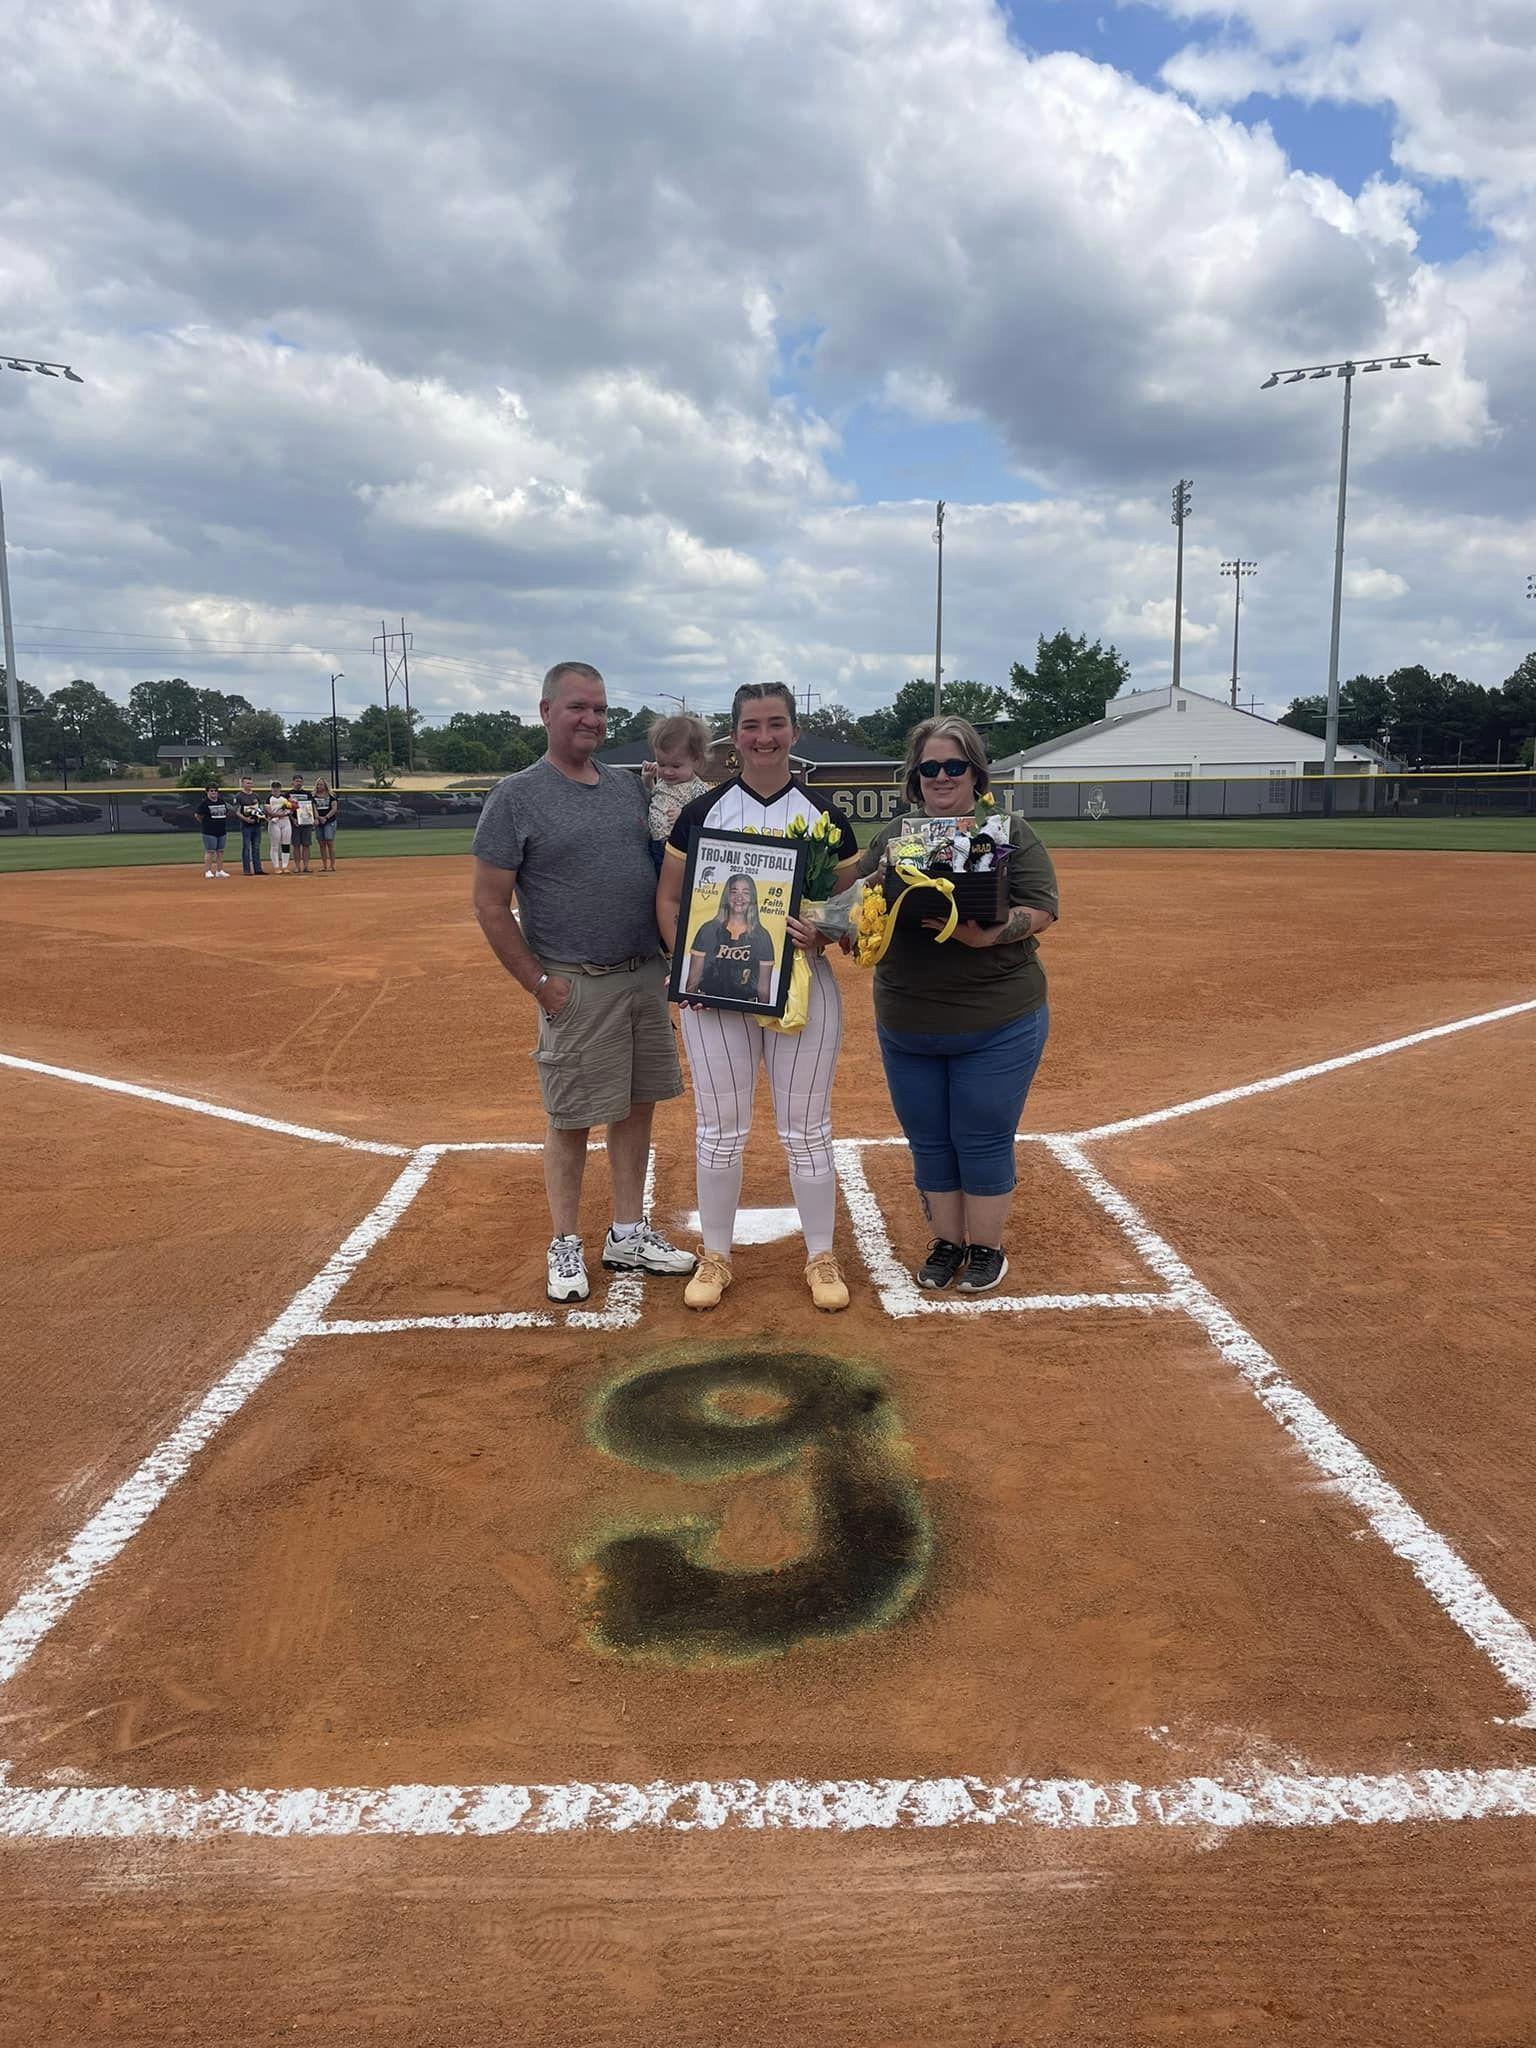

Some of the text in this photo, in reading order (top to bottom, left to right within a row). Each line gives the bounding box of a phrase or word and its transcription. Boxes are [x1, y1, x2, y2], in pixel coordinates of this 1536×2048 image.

[832, 789, 1024, 818] SOFL
[700, 847, 741, 865] TROJAN
[744, 853, 794, 871] SOFTBALL
[768, 886, 783, 898] #9
[760, 905, 786, 917] Martin
[763, 898, 784, 908] Faith
[740, 968, 751, 985] 9
[572, 1342, 934, 1668] 9
